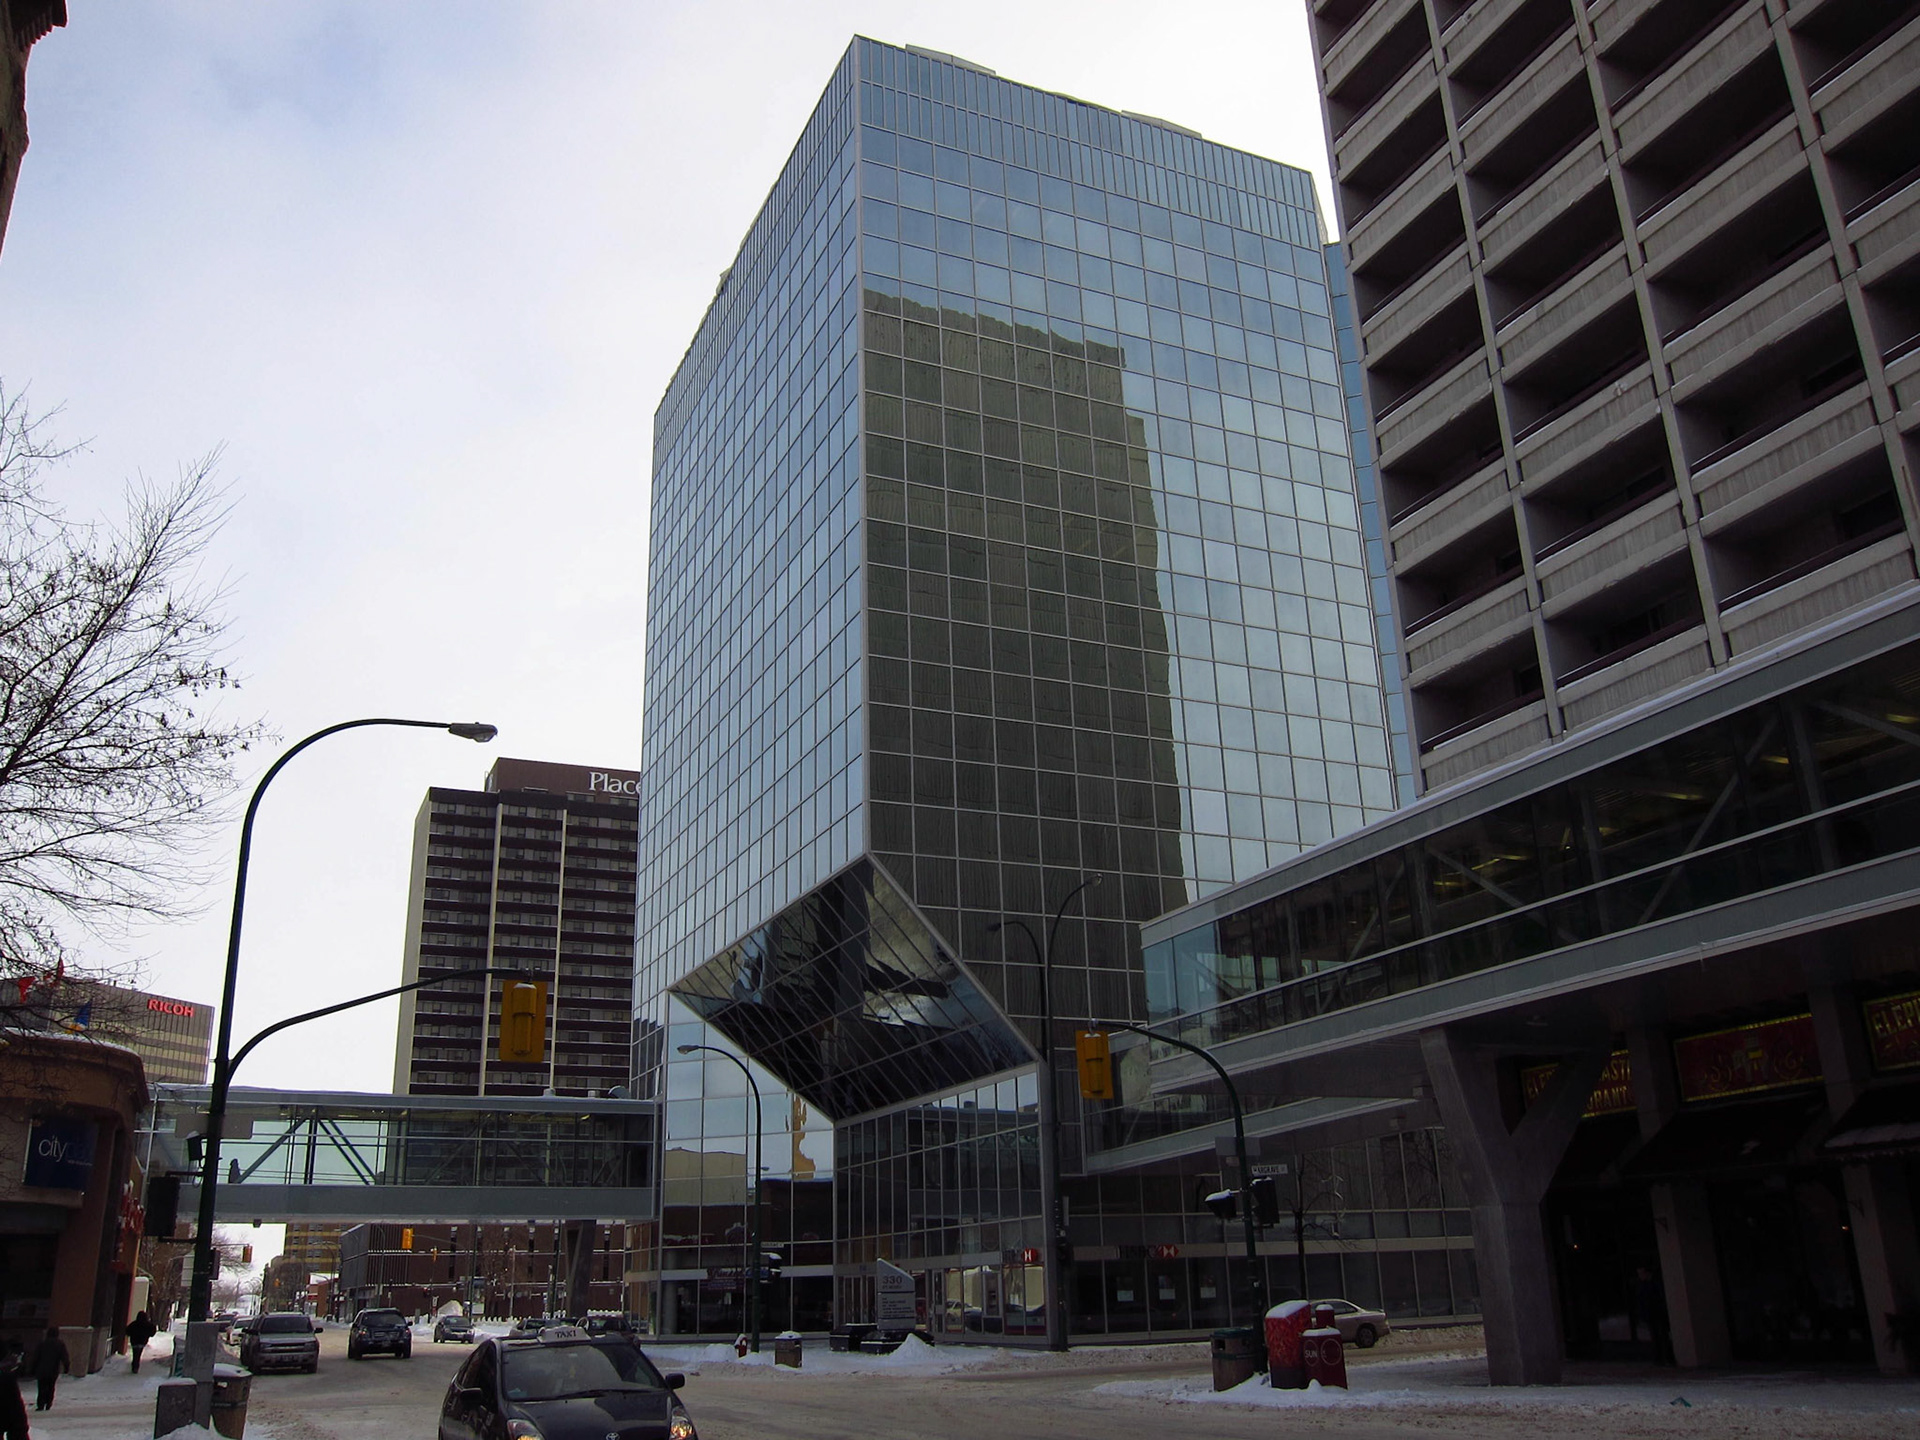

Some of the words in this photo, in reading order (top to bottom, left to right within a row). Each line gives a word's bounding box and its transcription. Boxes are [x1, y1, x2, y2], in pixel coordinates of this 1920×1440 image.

[147, 999, 194, 1017] RICOH
[882, 1275, 903, 1285] 330
[555, 1330, 577, 1339] TAXI
[1304, 1349, 1318, 1359] SUN
